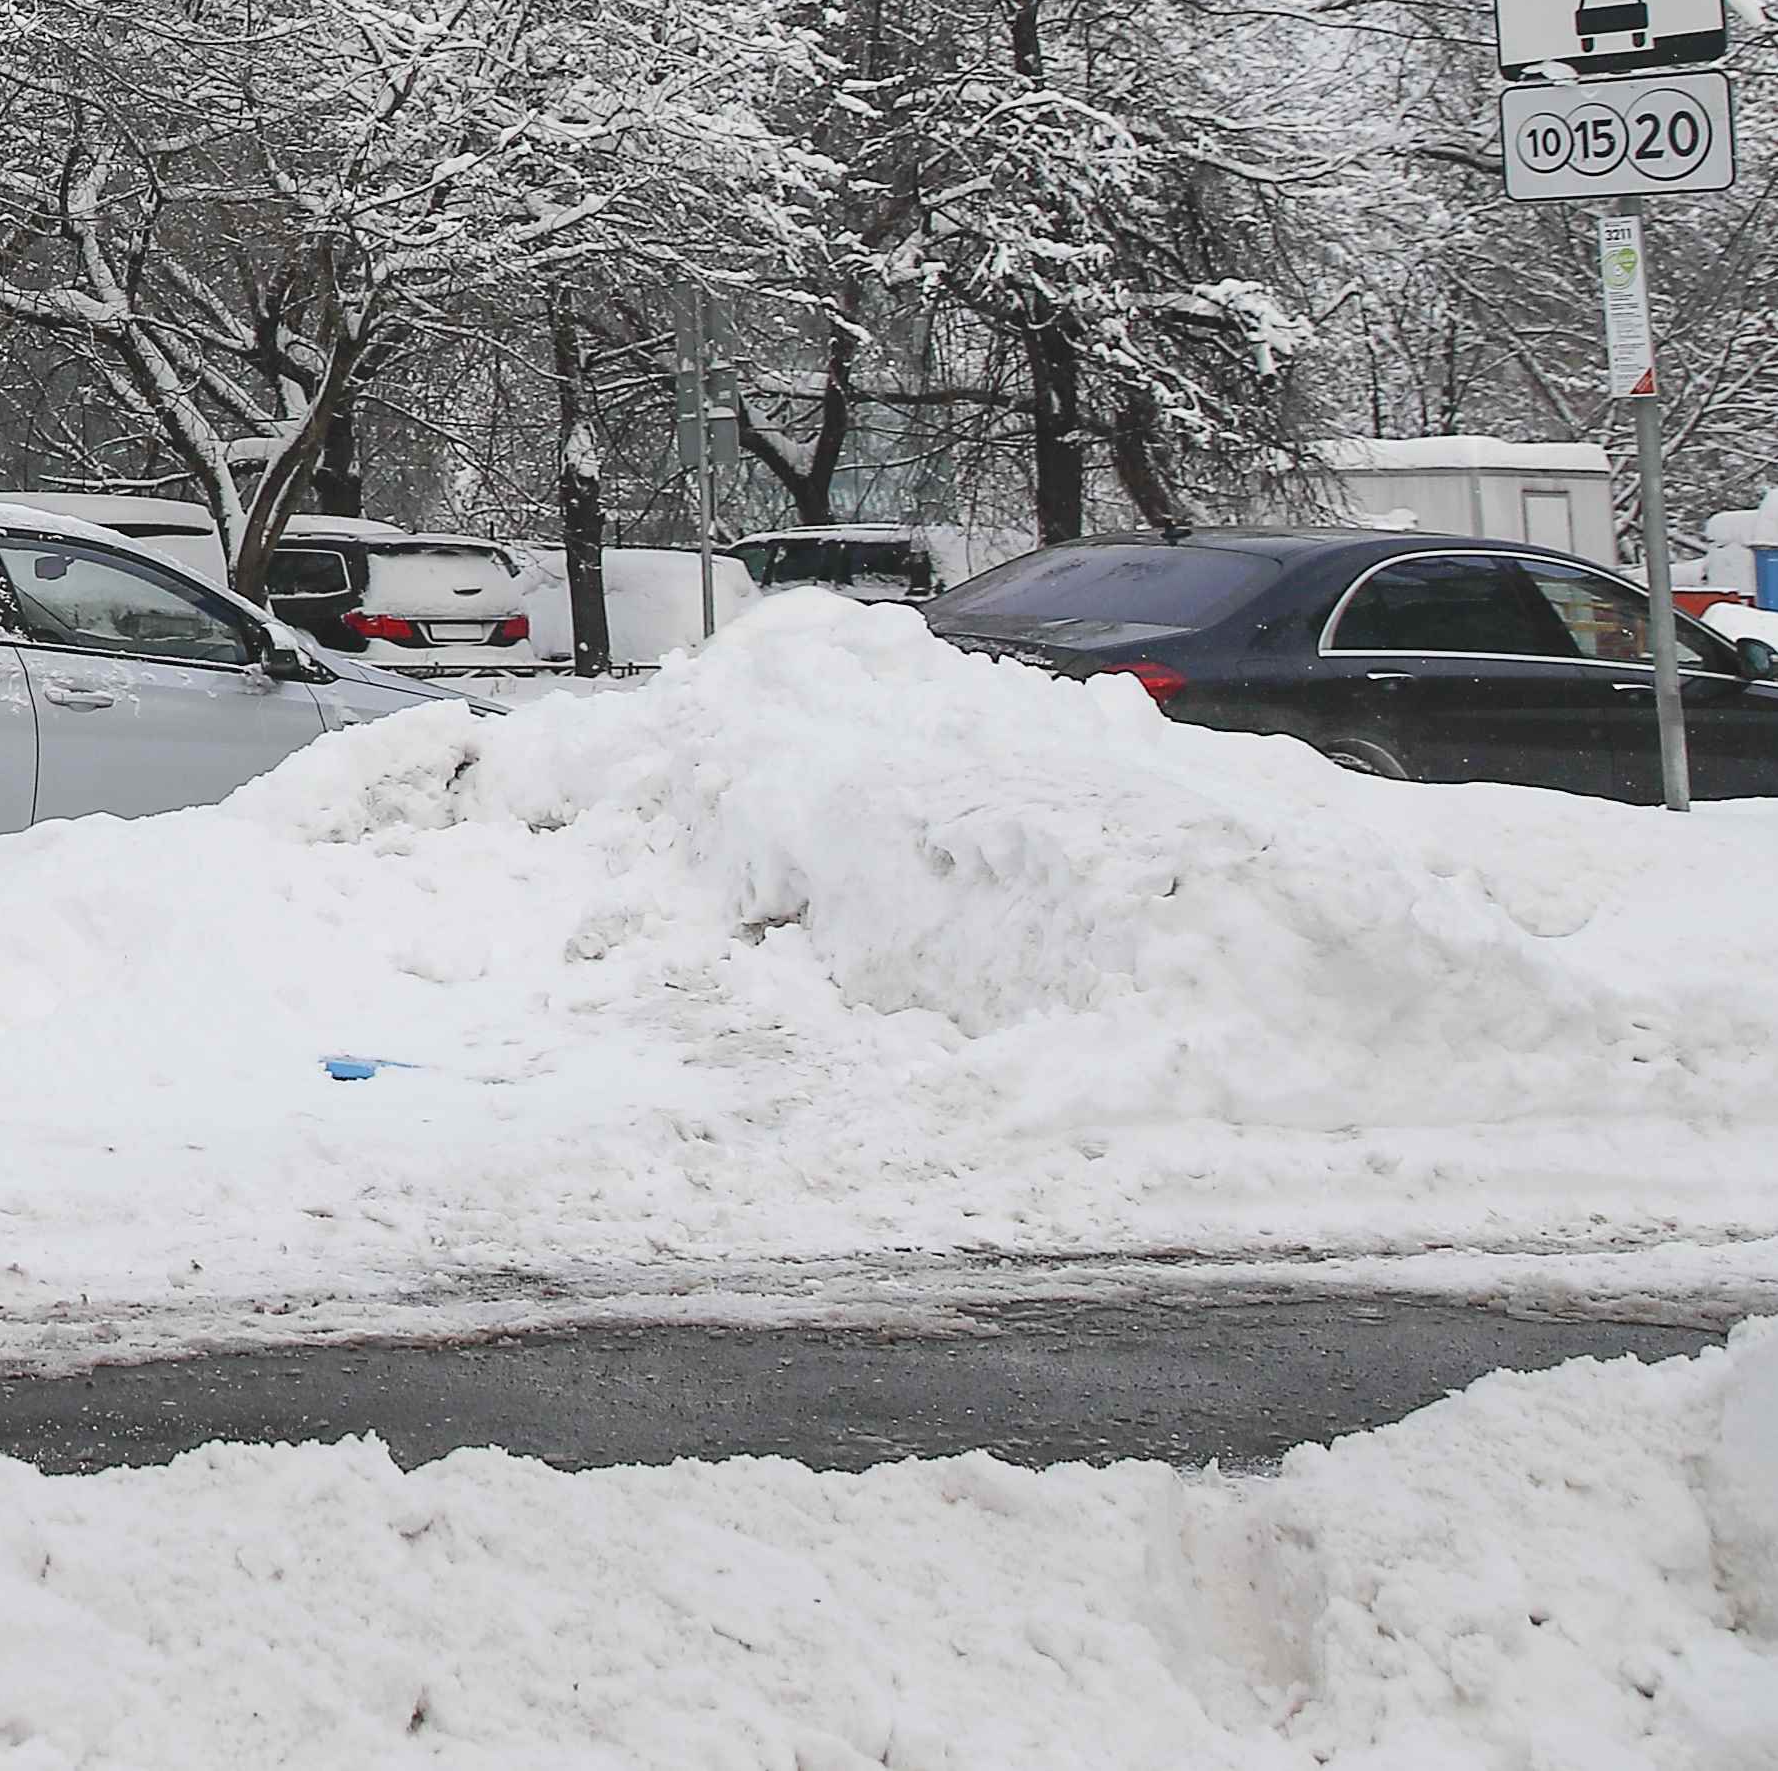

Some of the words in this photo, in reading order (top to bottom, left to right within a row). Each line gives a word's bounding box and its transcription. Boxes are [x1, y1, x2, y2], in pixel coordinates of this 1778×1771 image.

[1526, 128, 1561, 158] 10
[1574, 118, 1616, 159] 15
[1635, 110, 1700, 160] 20
[1605, 228, 1632, 241] 3211
